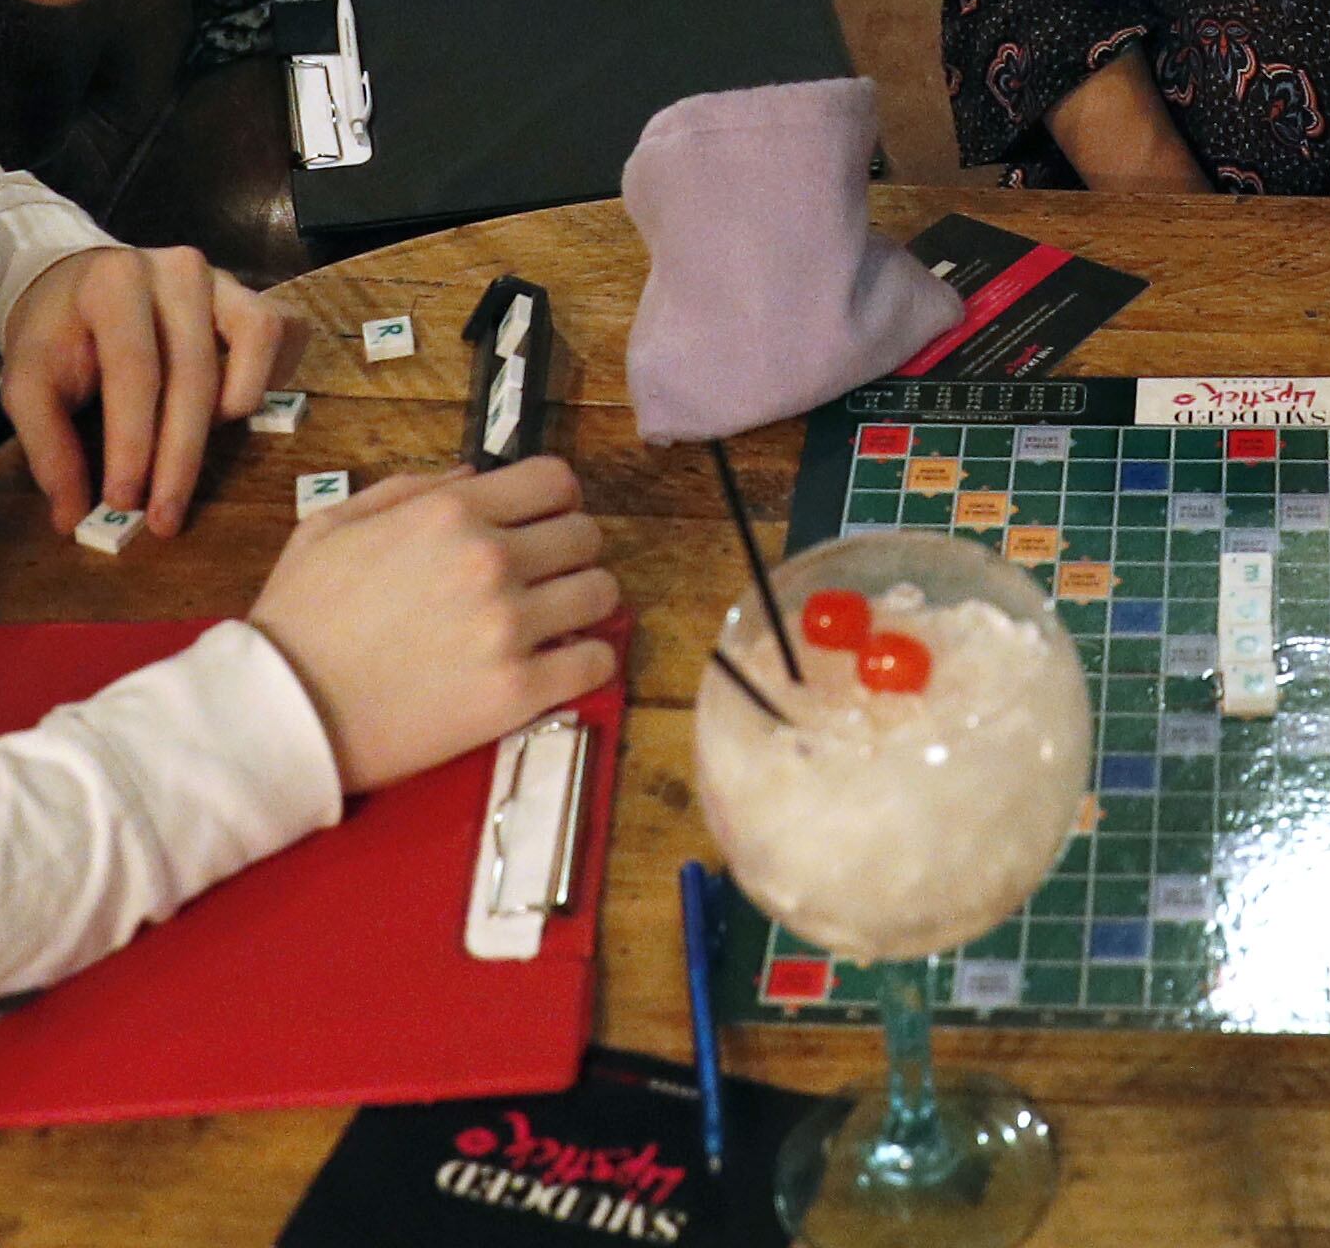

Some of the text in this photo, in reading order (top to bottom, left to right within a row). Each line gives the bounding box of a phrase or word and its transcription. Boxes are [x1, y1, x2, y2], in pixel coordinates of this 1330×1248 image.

[377, 323, 404, 338] R
[1197, 382, 1316, 411] Lipstick
[1174, 410, 1326, 425] SMUDGED
[313, 477, 339, 495] N
[104, 511, 129, 525] S
[435, 1159, 688, 1243] SMUDGED
